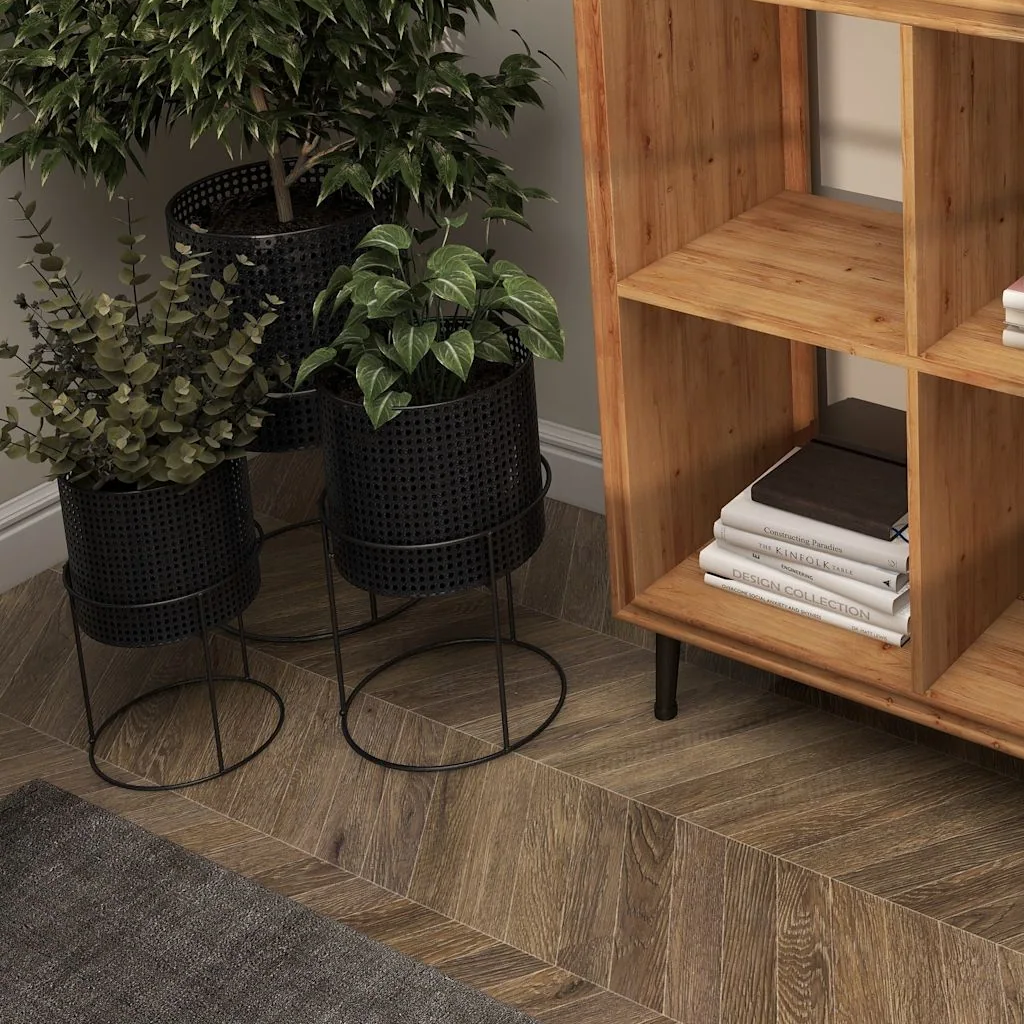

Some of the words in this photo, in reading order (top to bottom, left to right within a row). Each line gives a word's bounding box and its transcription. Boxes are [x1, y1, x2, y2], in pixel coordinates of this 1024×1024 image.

[763, 526, 810, 546] Constructing
[758, 543, 771, 551] THE
[776, 546, 830, 570] KINFOLK
[832, 565, 853, 576] TABLE
[781, 563, 814, 581] ENGINEERING
[721, 584, 748, 595] OVERCOME
[749, 592, 765, 602] SOCIAL
[788, 605, 799, 613] AND
[732, 568, 781, 592] DESIGN
[785, 586, 870, 621] COLLECTION
